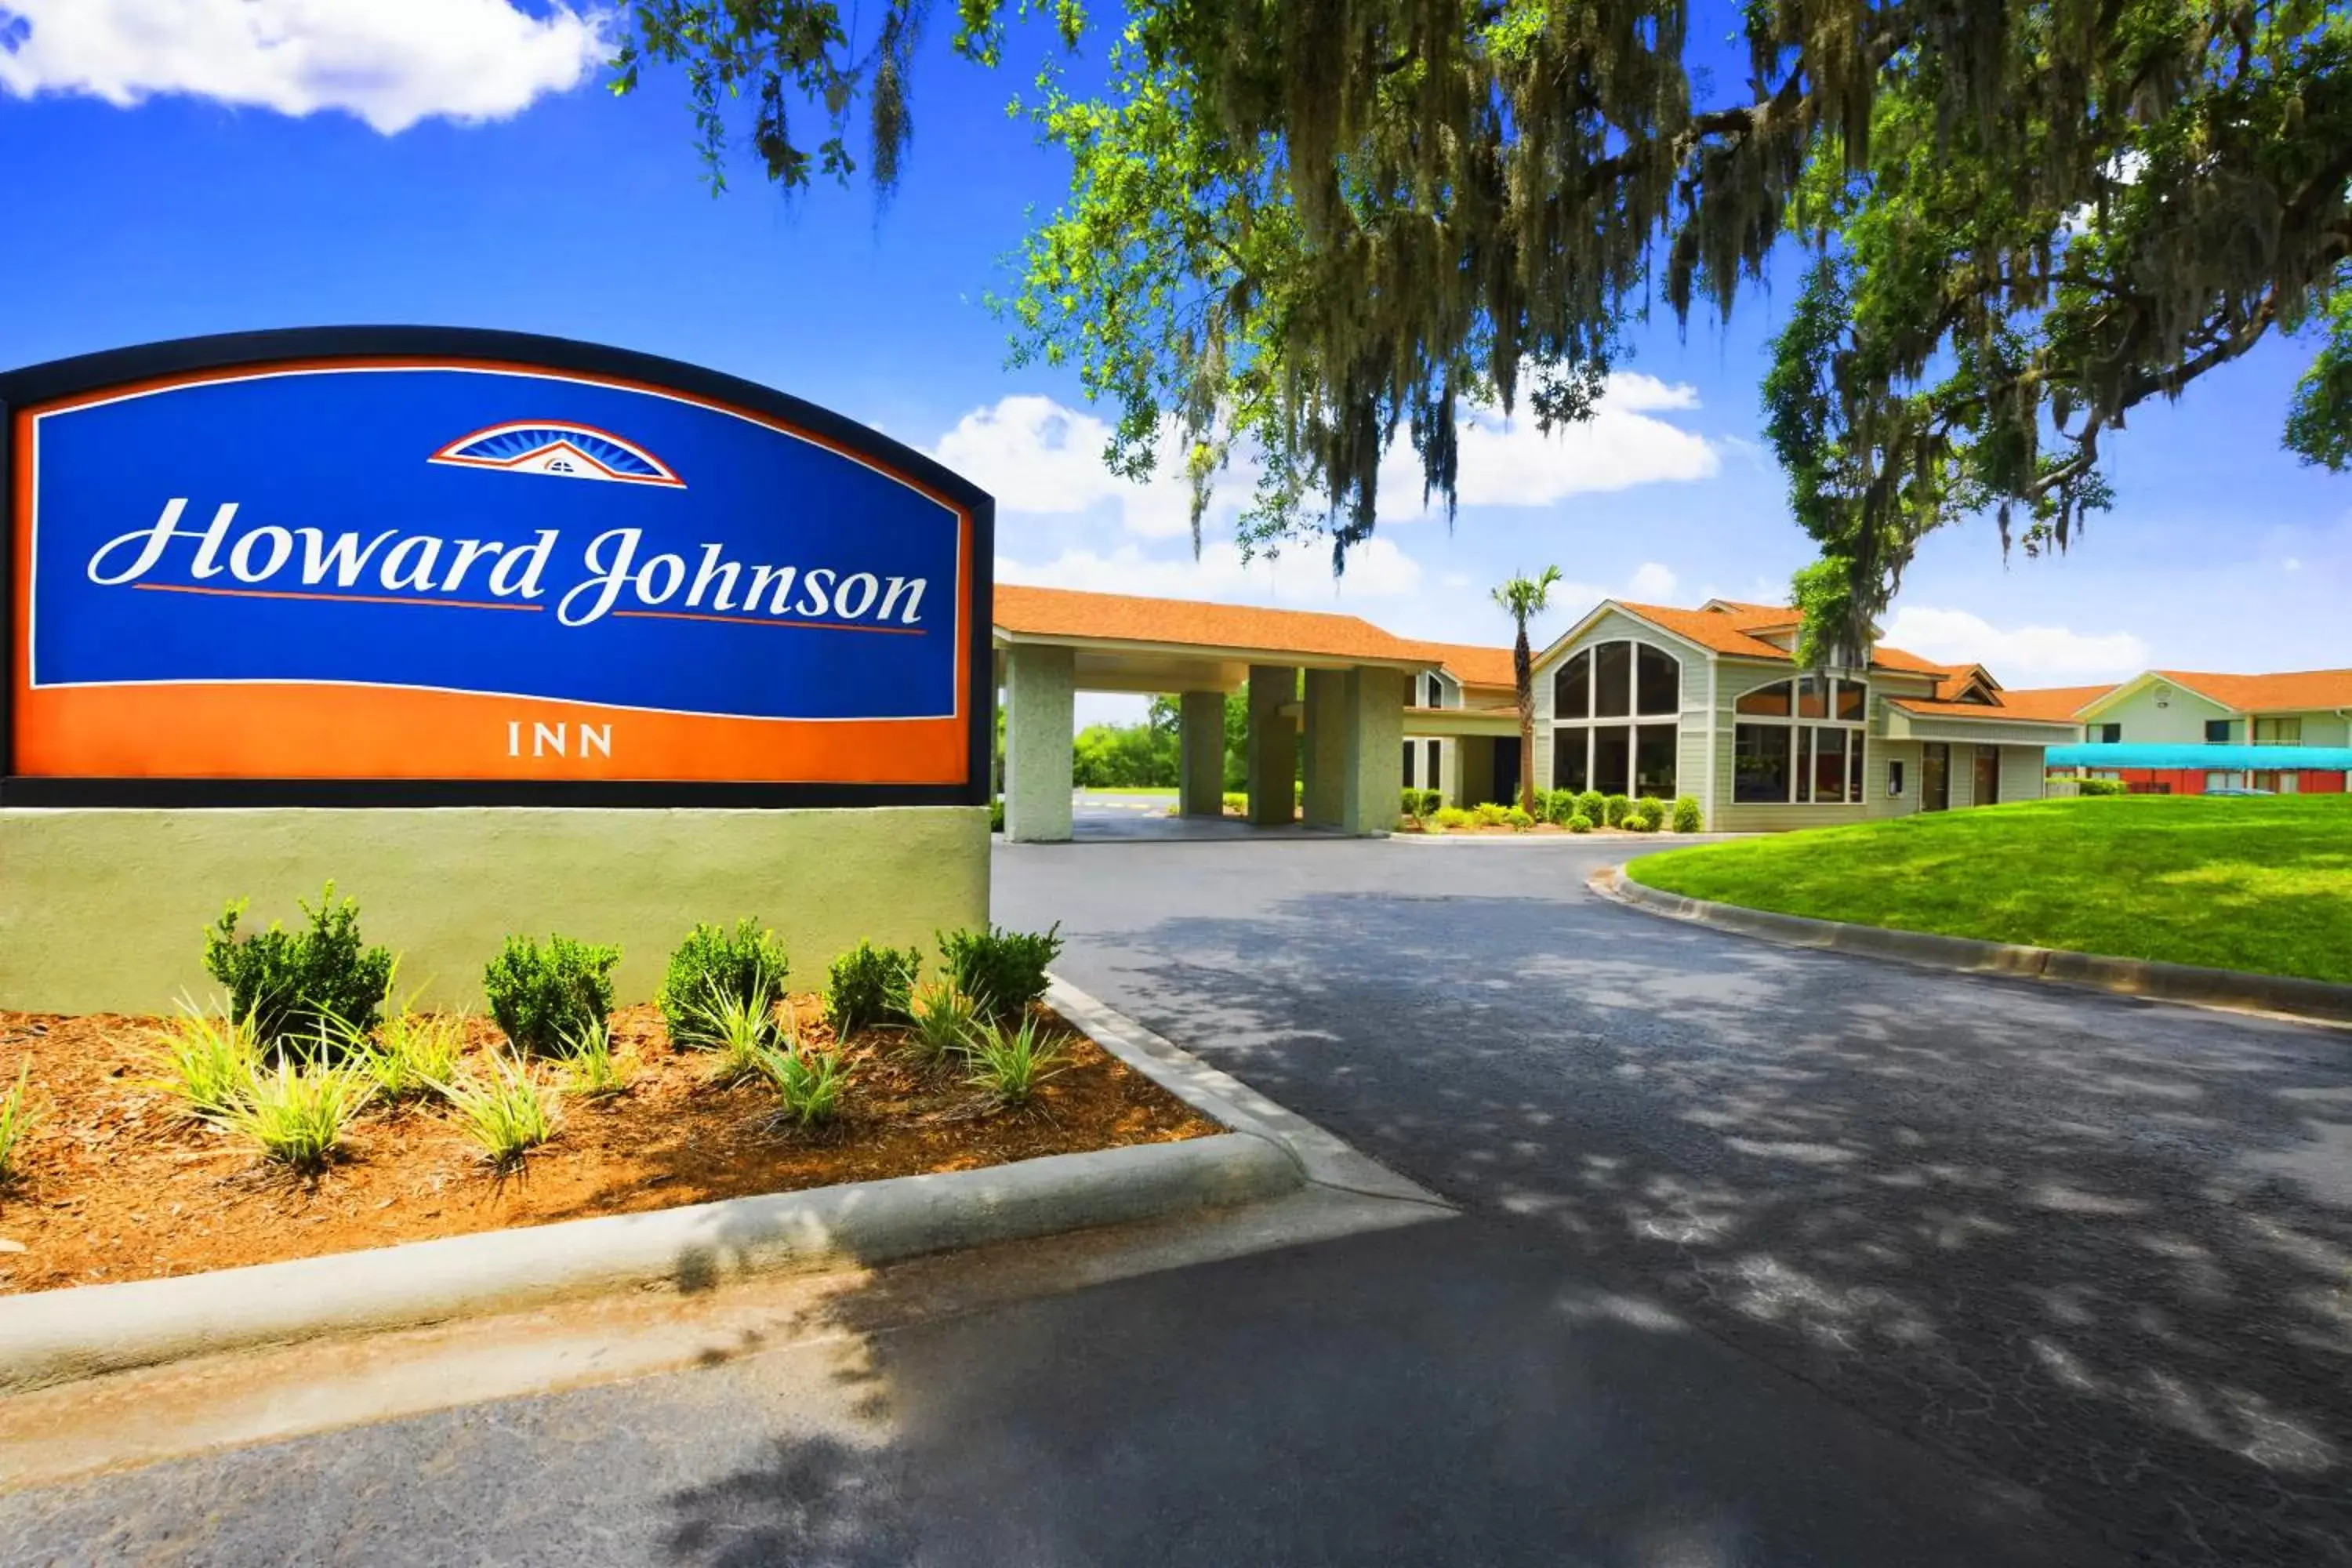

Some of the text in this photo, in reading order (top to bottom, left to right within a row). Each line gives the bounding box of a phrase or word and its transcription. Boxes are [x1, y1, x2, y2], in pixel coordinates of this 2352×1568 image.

[87, 498, 927, 626] Howard Johnson
[507, 721, 613, 757] INN
